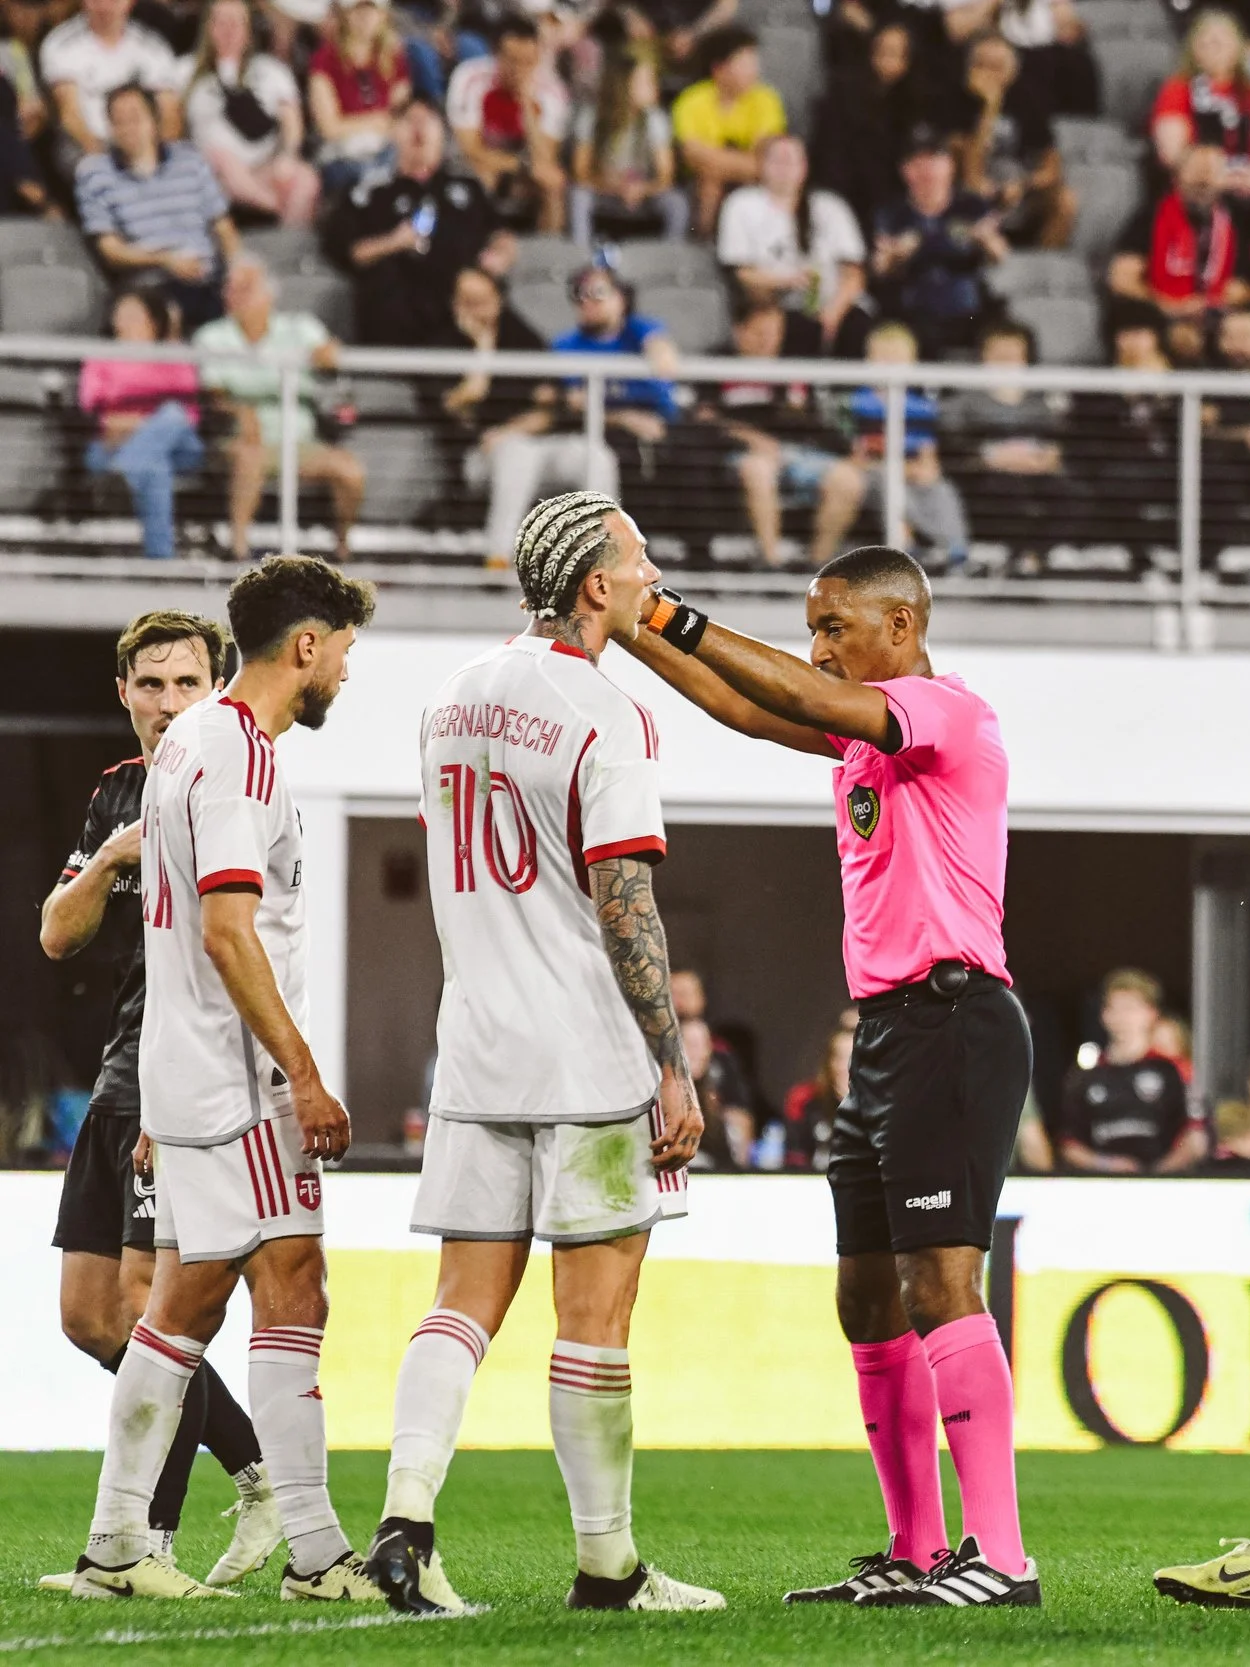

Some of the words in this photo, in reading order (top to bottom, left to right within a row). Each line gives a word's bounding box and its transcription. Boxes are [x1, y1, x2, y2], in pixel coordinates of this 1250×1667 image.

[431, 704, 564, 756] BERNADESCHI
[853, 801, 871, 817] PRO
[440, 764, 538, 895] 10
[905, 1190, 951, 1210] capelli
